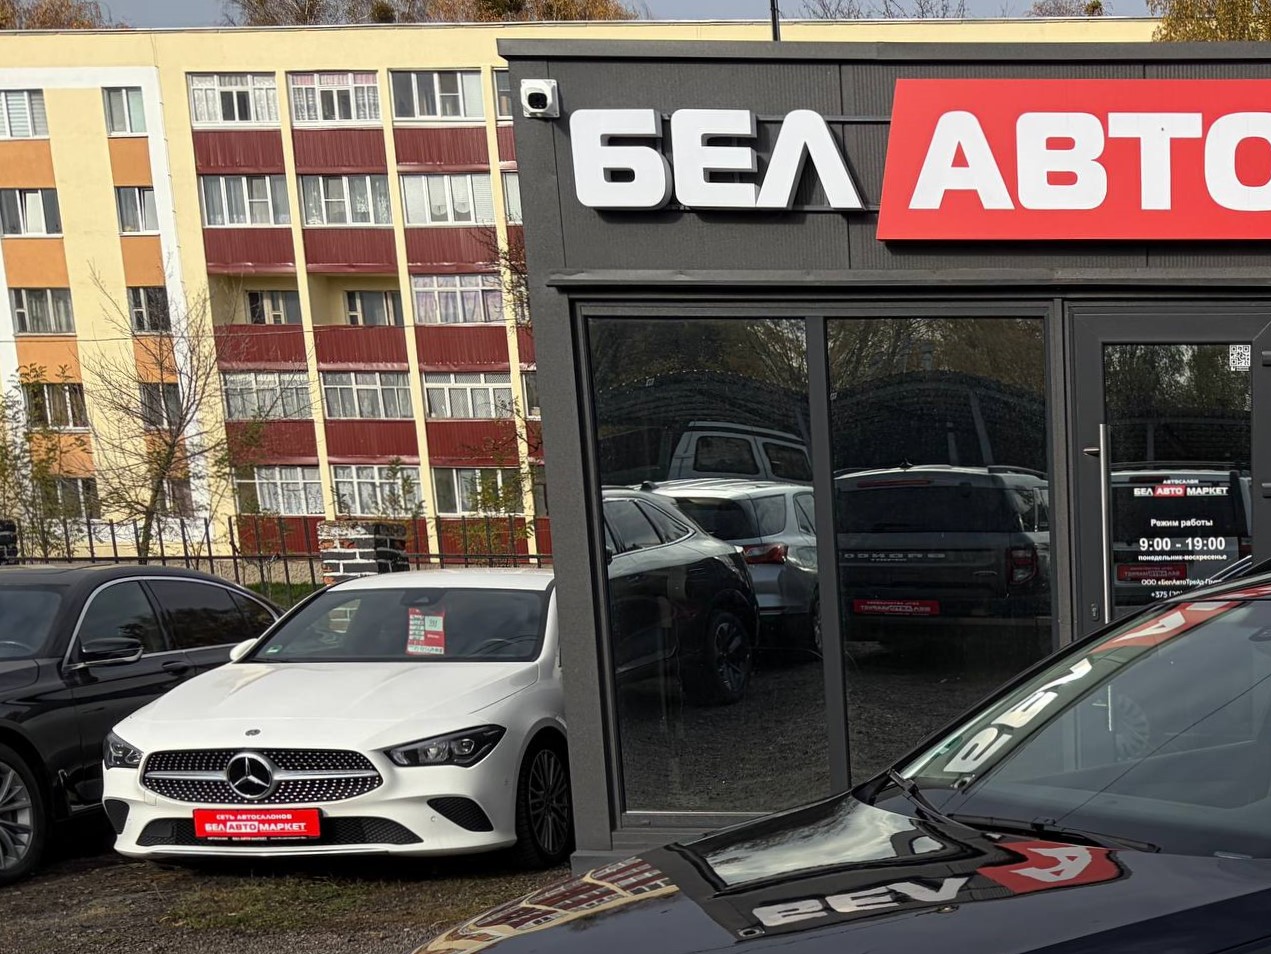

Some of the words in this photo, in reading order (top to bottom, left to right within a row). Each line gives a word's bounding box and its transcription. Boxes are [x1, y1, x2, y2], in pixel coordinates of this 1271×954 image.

[569, 108, 866, 210] БЕЛ
[1133, 487, 1153, 496] БЕЛ
[1156, 487, 1183, 495] АВТО
[1186, 487, 1228, 496] МАРКЕТ
[1150, 519, 1179, 527] Режим
[1181, 519, 1213, 528] работы
[1139, 537, 1171, 551] 9:00
[1186, 537, 1225, 550] 19:00
[204, 823, 226, 832] БЕЛ
[227, 822, 258, 831] АВТО
[259, 823, 306, 832] МАРКЕТ
